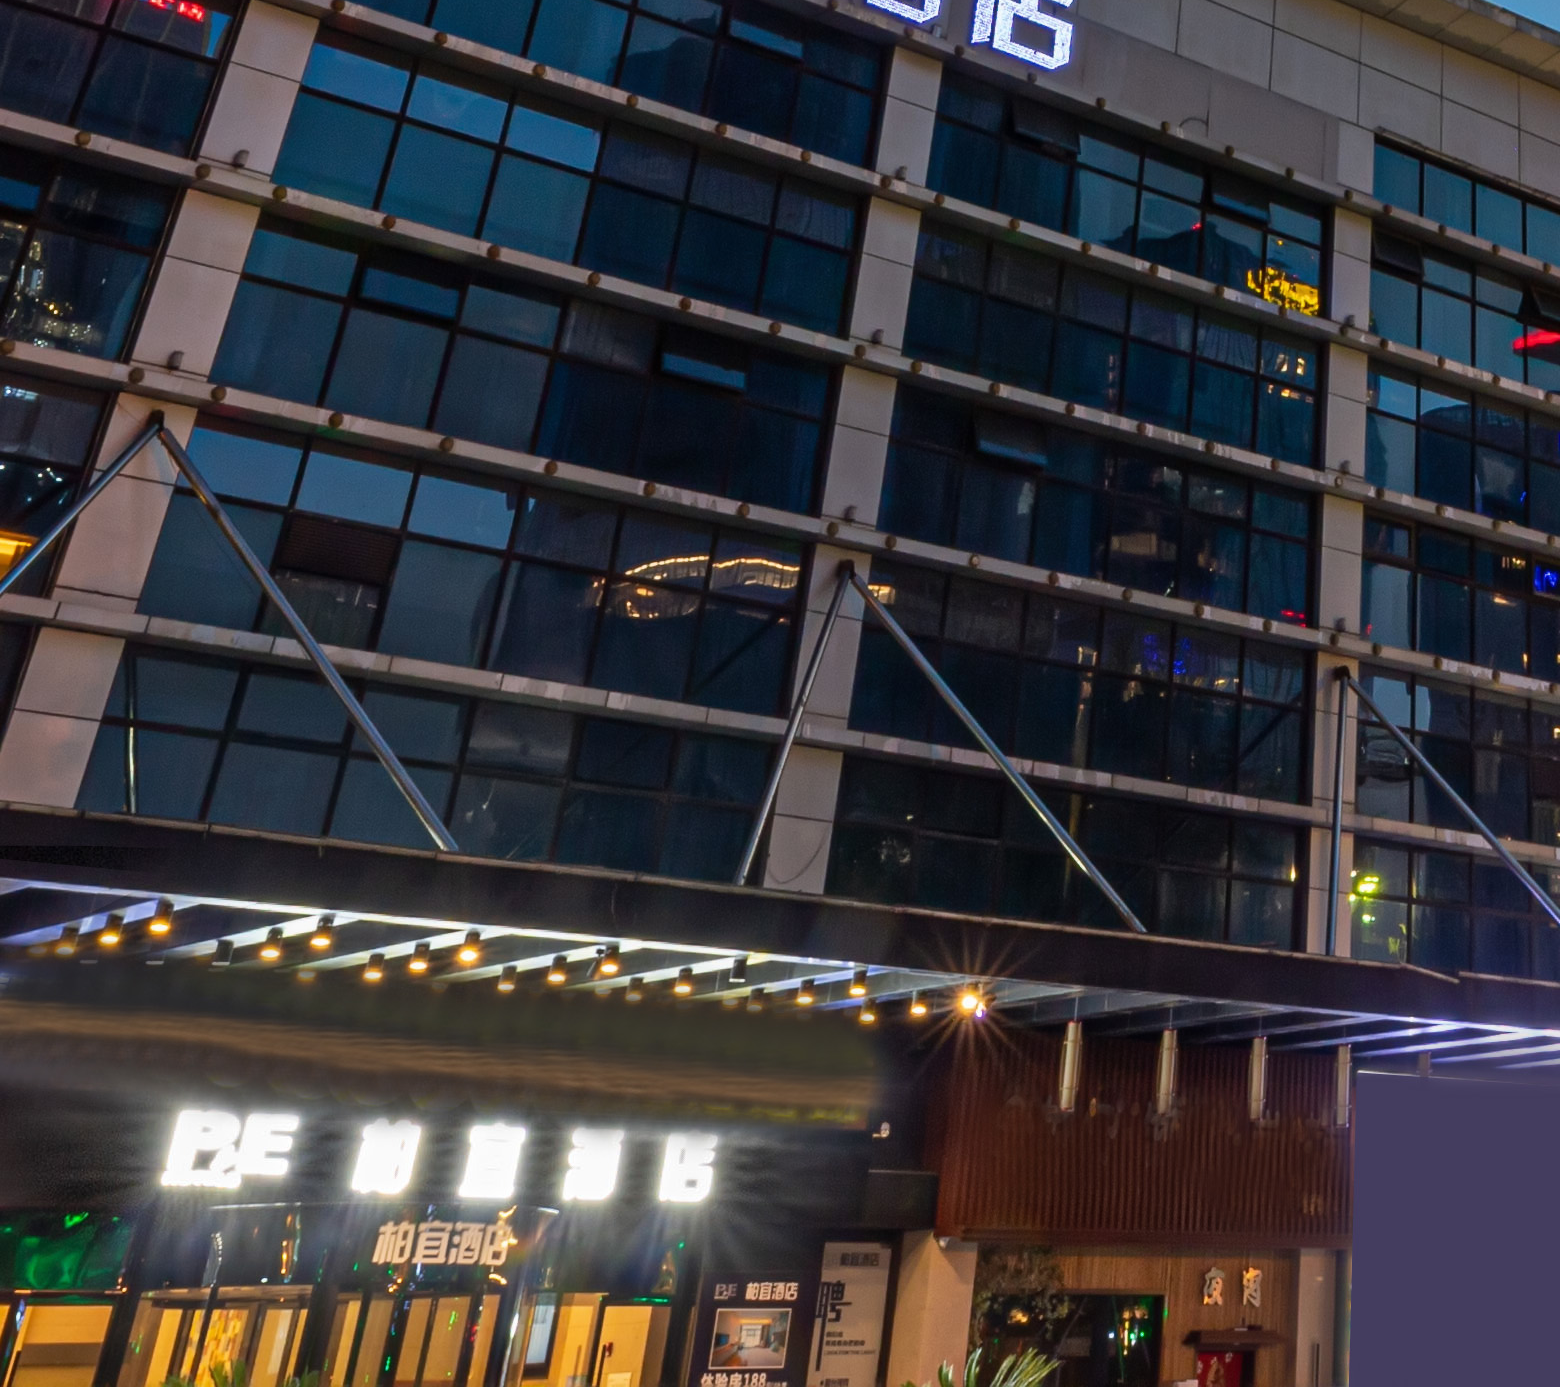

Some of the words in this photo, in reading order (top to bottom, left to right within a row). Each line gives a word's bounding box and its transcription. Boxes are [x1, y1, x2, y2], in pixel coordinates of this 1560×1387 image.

[372, 1221, 512, 1266] 柏宜酒店
[745, 1281, 799, 1301] 柏宜酒店
